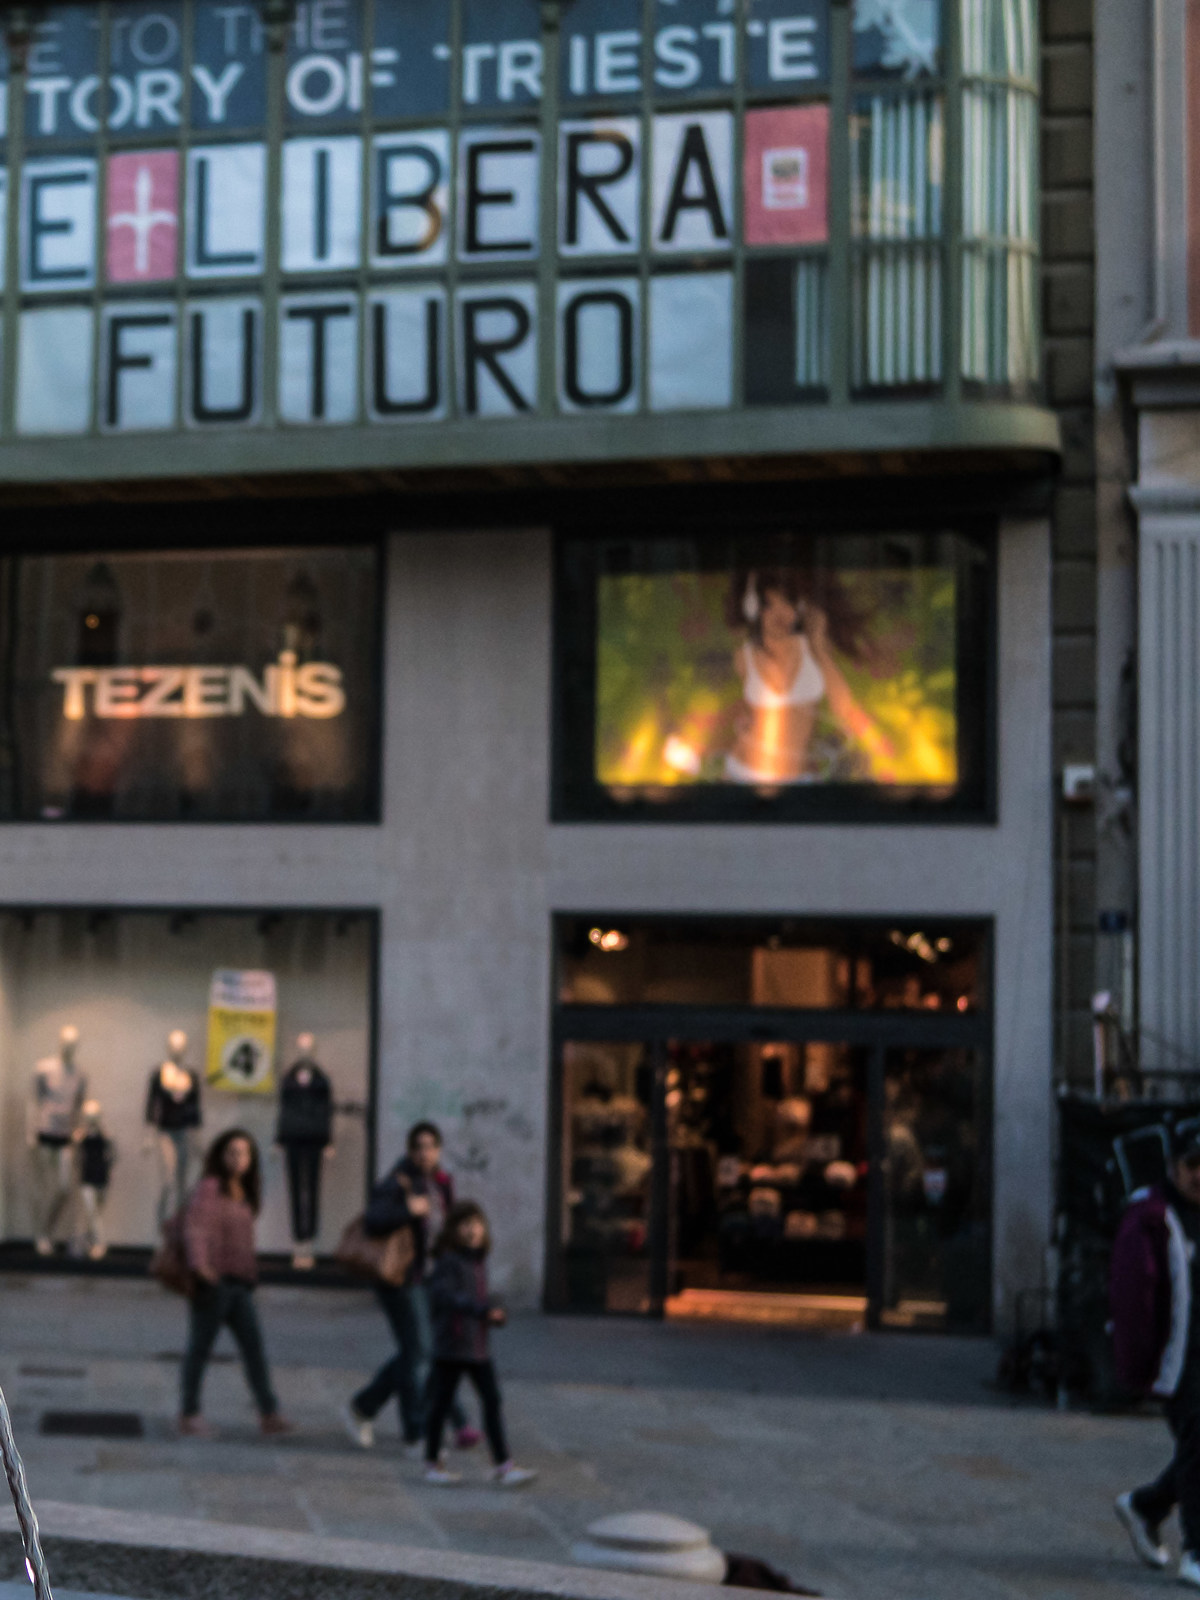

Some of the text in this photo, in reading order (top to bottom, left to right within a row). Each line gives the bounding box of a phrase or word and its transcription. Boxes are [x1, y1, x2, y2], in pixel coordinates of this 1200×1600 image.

[90, 13, 181, 66] TO
[212, 0, 351, 56] THE
[286, 49, 398, 115] OF
[434, 18, 818, 104] TRIESTE
[193, 123, 728, 268] LIBERA
[107, 290, 635, 426] FUTURO
